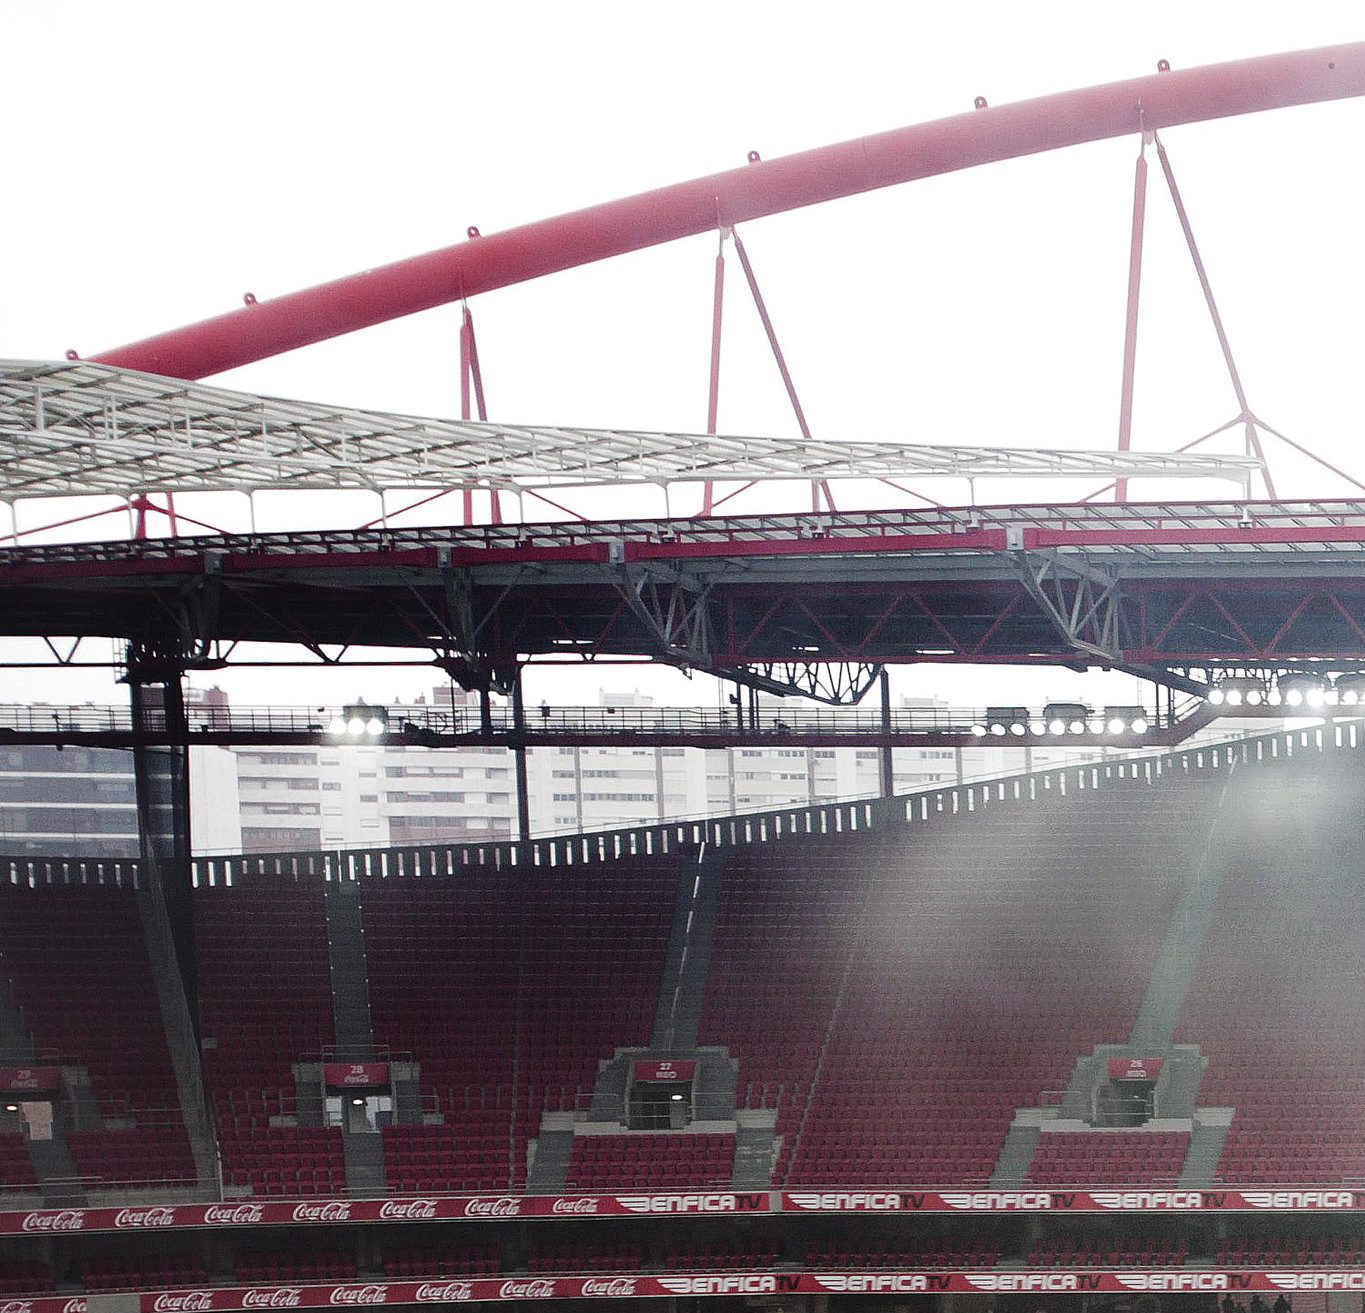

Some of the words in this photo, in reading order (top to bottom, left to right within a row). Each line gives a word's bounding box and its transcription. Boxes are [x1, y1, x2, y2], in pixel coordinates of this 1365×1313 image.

[618, 1195, 736, 1212] BENFICA
[788, 1194, 901, 1211] BENFICA
[939, 1193, 1051, 1210] BENFICA
[1090, 1193, 1201, 1209] BENFICA
[1239, 1192, 1353, 1208] BENFICA
[657, 1278, 778, 1293] BENFICA
[814, 1276, 926, 1291] BENFICA
[964, 1275, 1077, 1290] BENFICA
[1115, 1274, 1226, 1289] BENFICA
